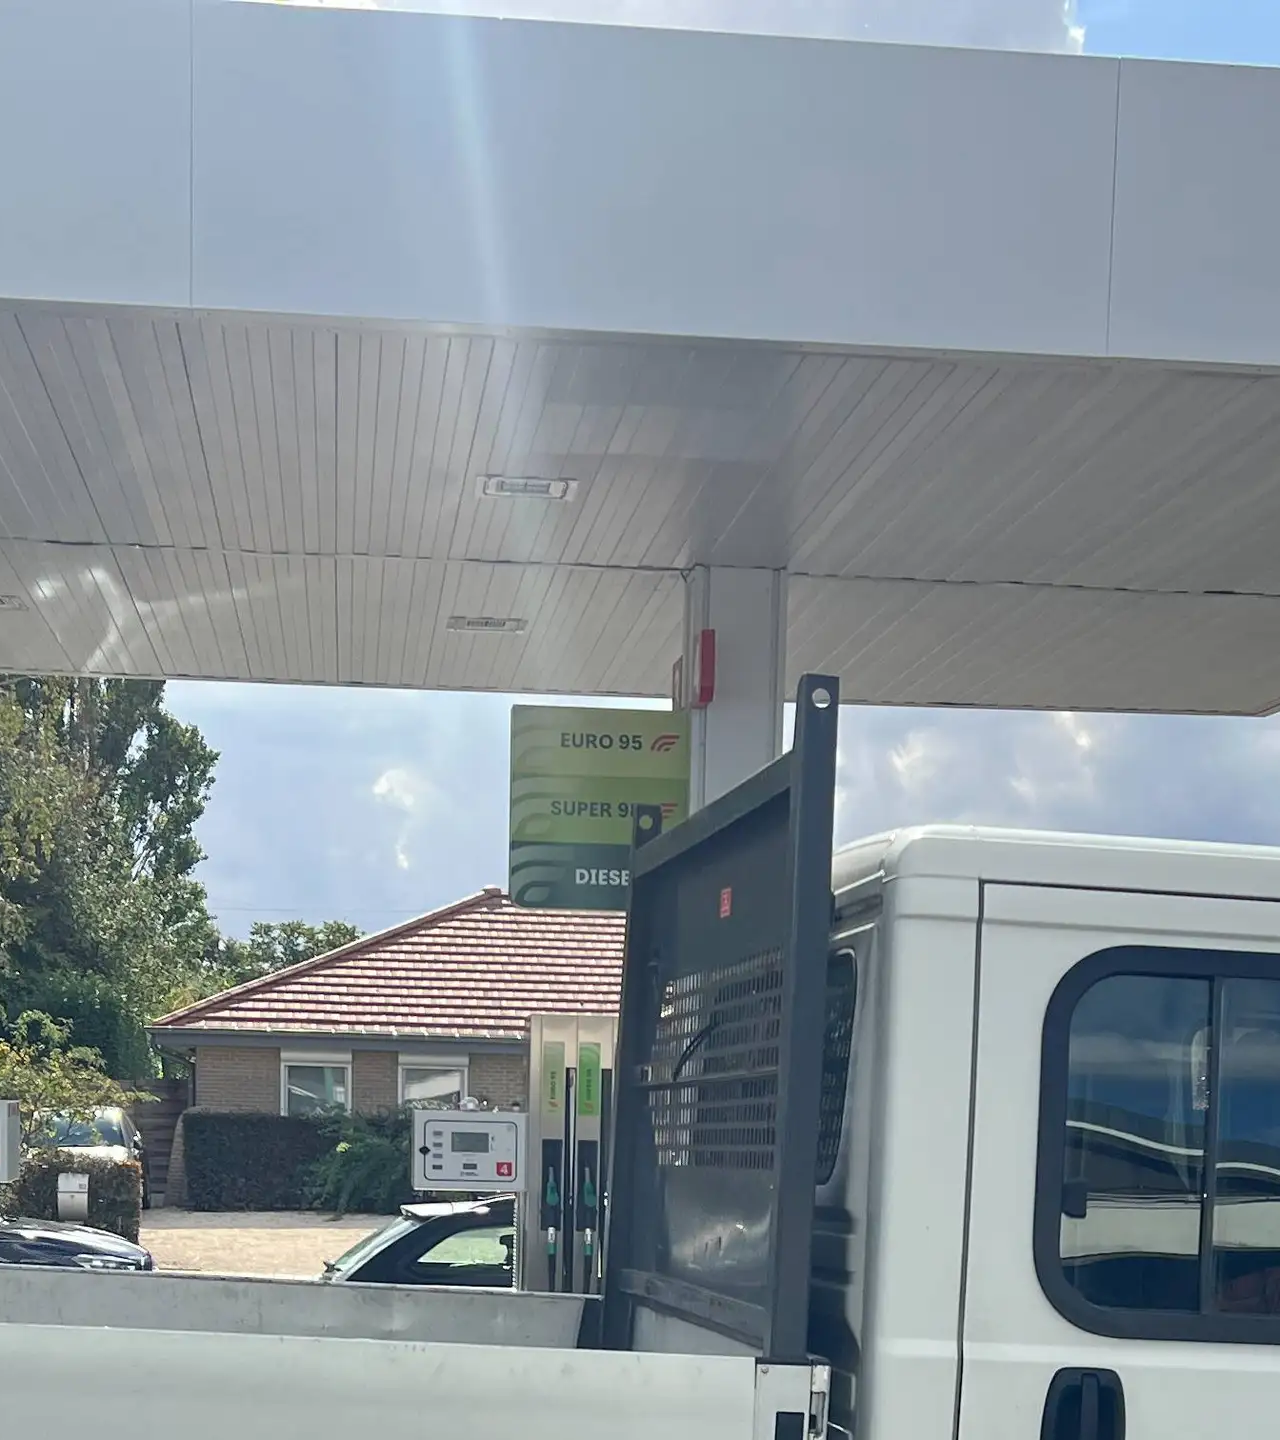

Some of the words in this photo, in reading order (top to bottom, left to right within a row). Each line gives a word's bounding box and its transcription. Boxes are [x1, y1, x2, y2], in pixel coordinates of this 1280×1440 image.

[561, 732, 614, 749] EURO
[618, 734, 643, 751] 95
[551, 800, 612, 818] SUPER
[575, 868, 630, 886] DIESE
[499, 1164, 508, 1175] 4
